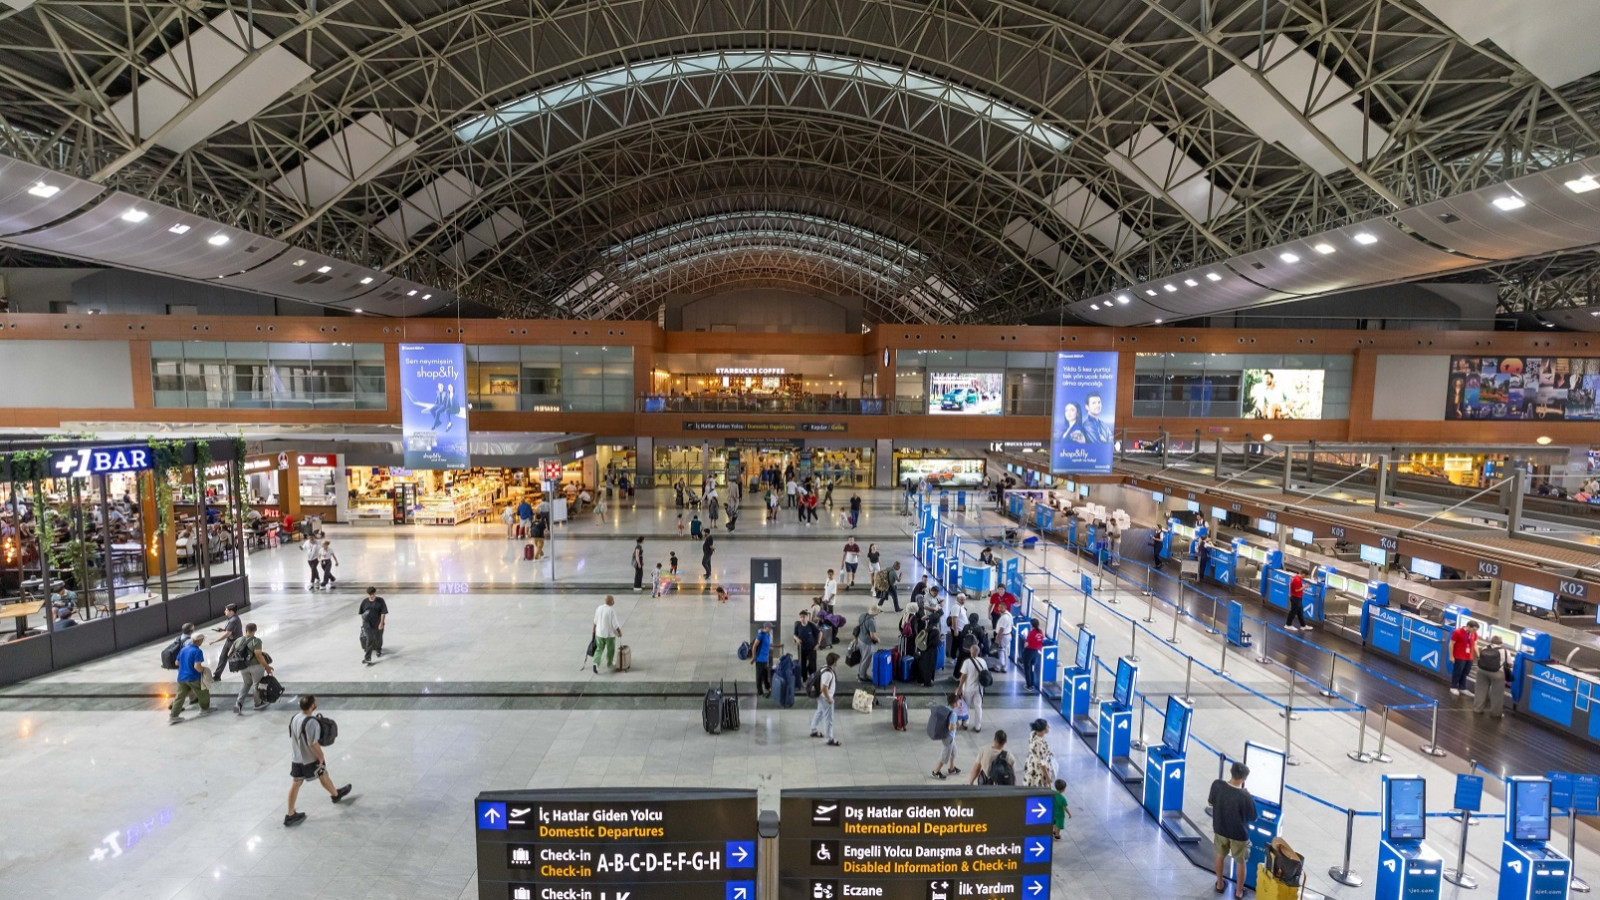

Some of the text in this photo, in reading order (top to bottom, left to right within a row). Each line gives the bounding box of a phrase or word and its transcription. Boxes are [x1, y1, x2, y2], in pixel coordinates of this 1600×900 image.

[417, 366, 459, 380] shop&fly
[94, 450, 147, 471] BAR
[1331, 526, 1344, 537] K05
[1478, 562, 1498, 575] K03
[1560, 581, 1584, 596] K02
[1380, 612, 1397, 623] AJet
[1418, 626, 1437, 637] AJet
[1541, 670, 1567, 686] AJet
[539, 807, 663, 823] İç Hatlar Giden Yolcu
[845, 806, 974, 821] Dış Hatlar Giden Yolcu
[539, 826, 664, 839] Domestic Departures
[845, 822, 987, 835] International Departures
[540, 849, 591, 861] Check-in
[844, 844, 1021, 860] Engelli Yolcu Danışma & Check-in
[597, 851, 720, 872] A-B-C-D-E-F-G-H
[844, 859, 1018, 873] Disabled Information & Check-in
[541, 865, 591, 877] Check-in
[541, 888, 592, 899] Check-in
[843, 885, 883, 896] Eczane
[959, 882, 1014, 895] İlk Yardım
